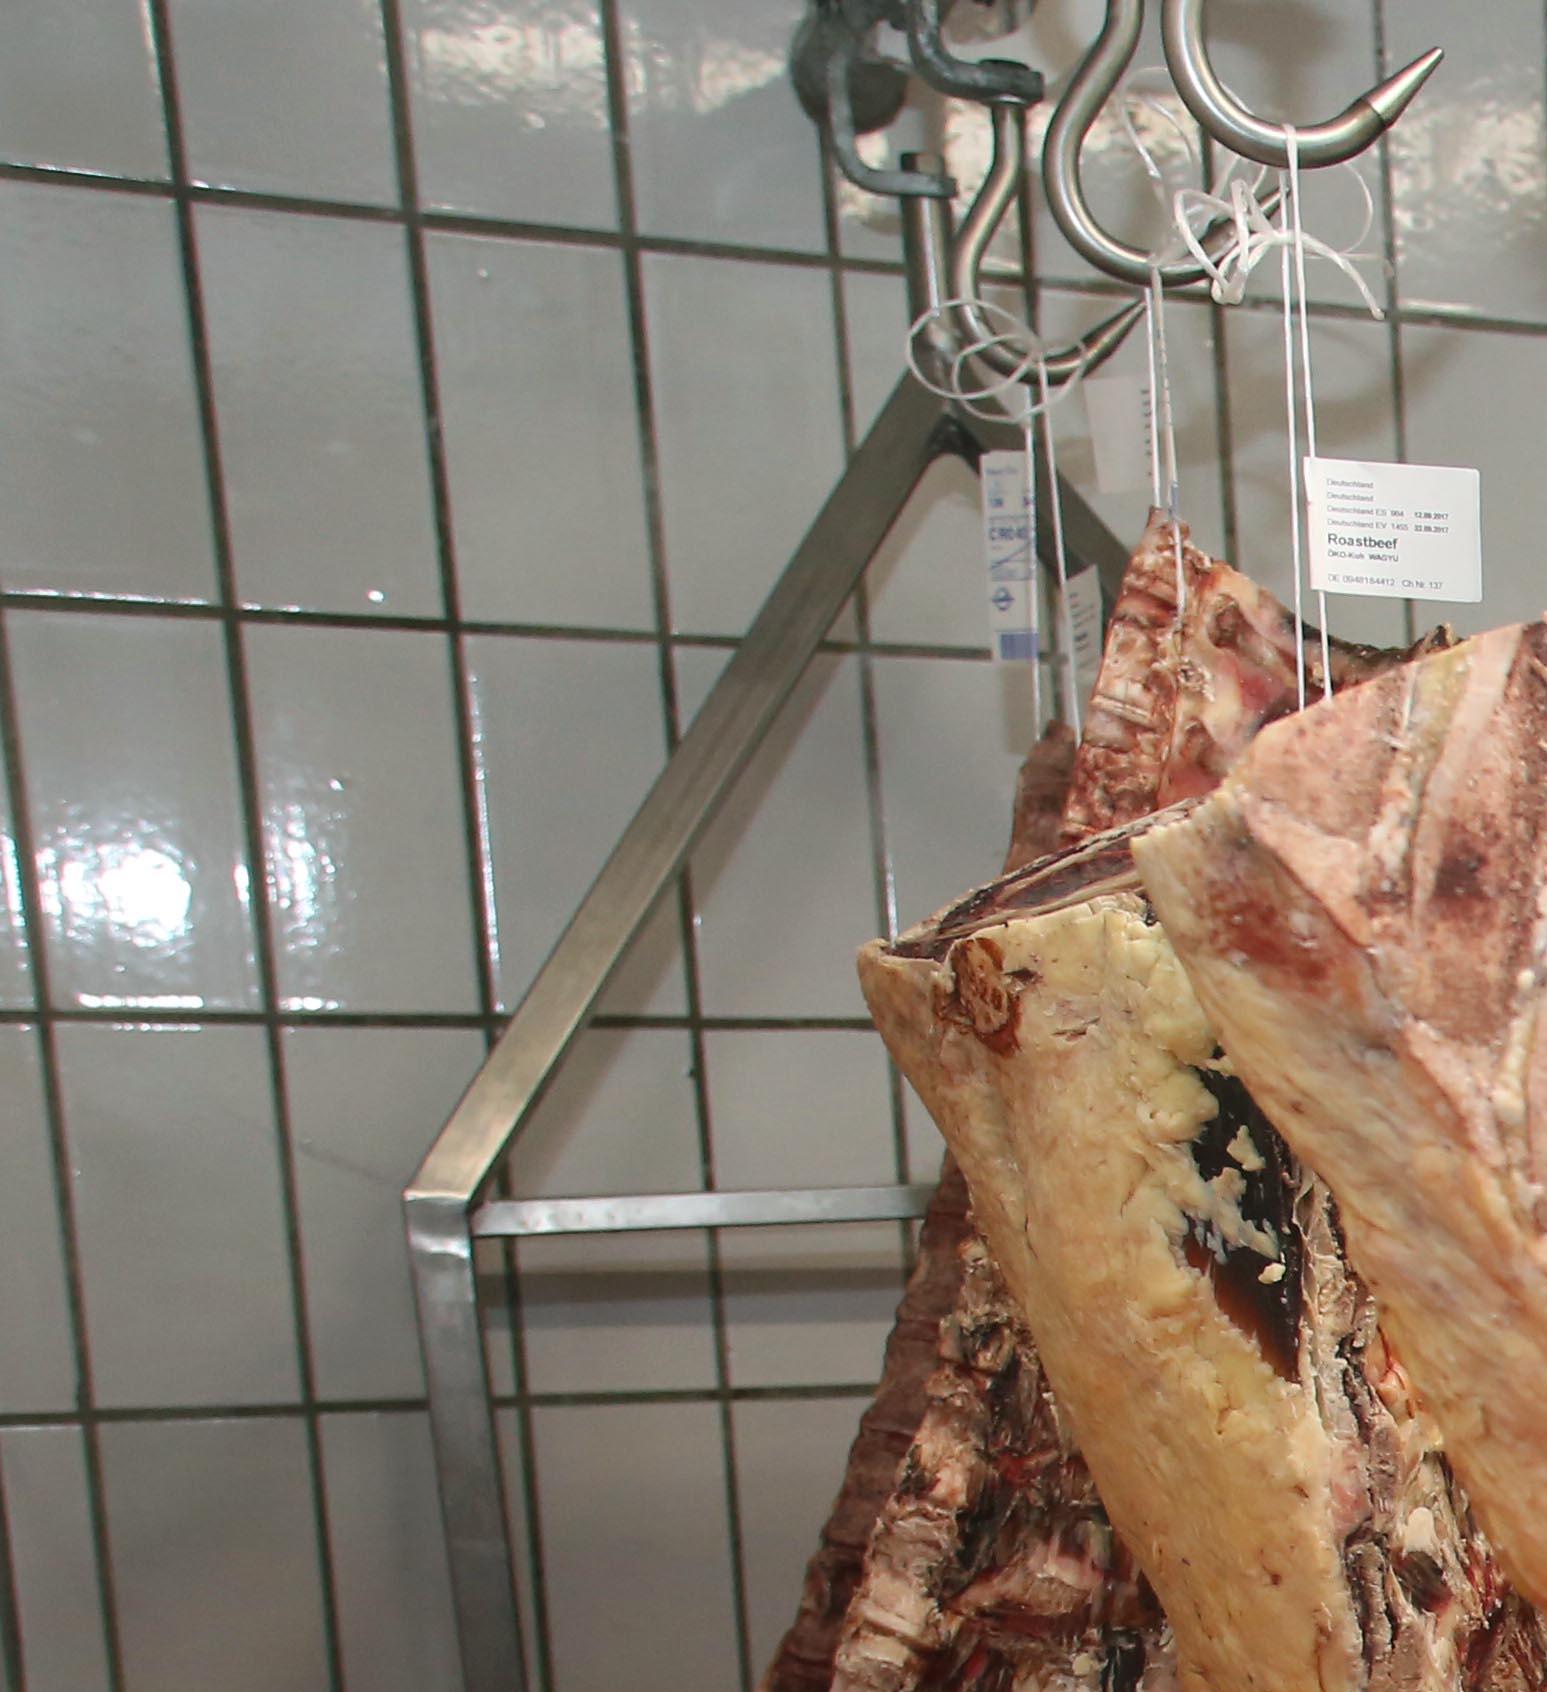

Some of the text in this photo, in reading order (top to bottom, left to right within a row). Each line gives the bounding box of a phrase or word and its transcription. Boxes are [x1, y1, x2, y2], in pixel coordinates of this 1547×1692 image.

[1326, 478, 1374, 488] Deutschland
[1326, 492, 1374, 502] Deutschland
[1327, 532, 1399, 550] Roastbeef
[1368, 553, 1399, 562] WAGYU
